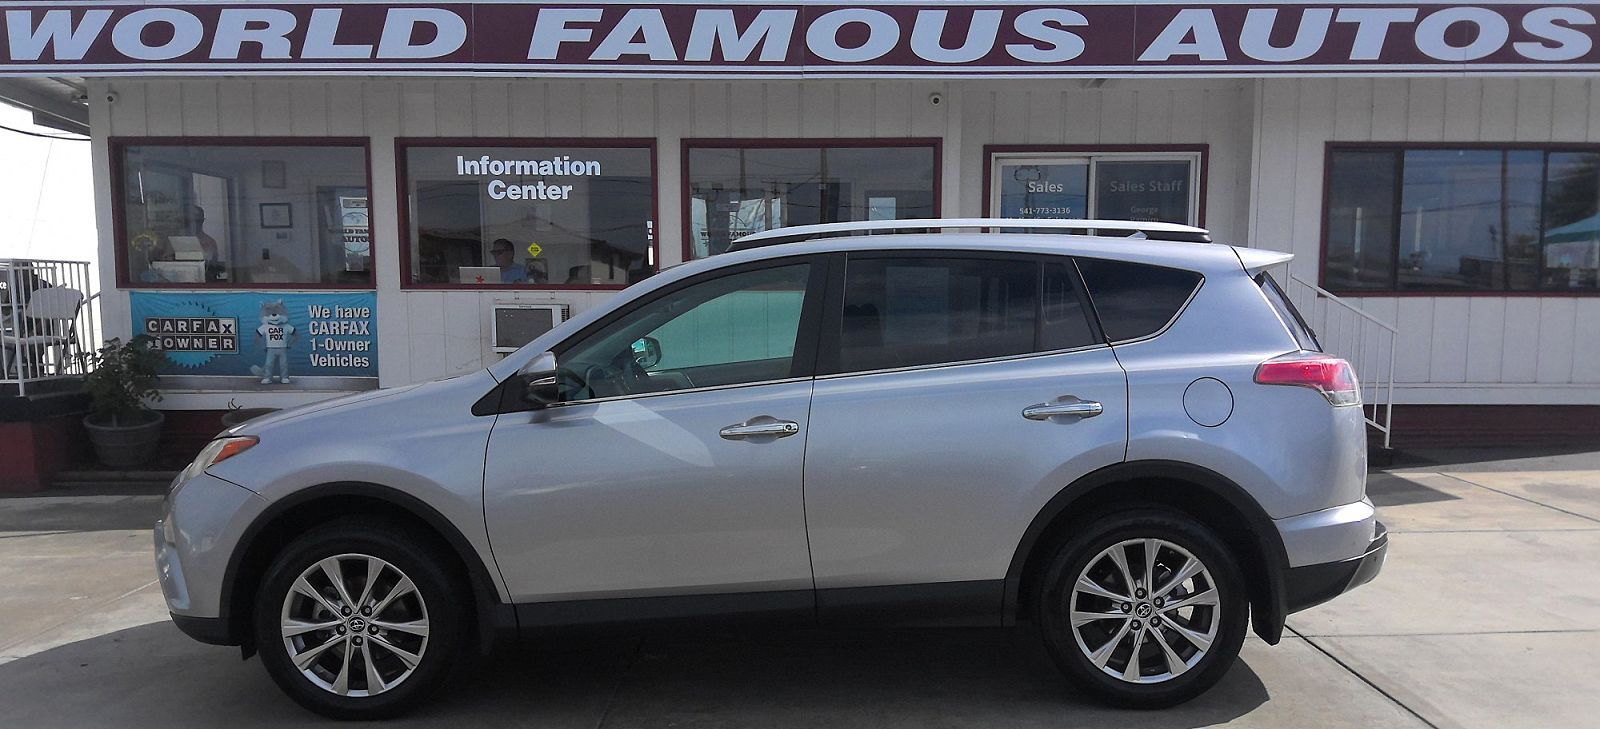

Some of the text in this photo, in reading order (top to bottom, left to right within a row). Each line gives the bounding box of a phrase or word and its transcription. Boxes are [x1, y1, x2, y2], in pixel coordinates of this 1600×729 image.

[3, 6, 1597, 62] WORLD FAMOUS AUTOS
[457, 155, 601, 176] Information
[488, 180, 573, 200] Center
[1028, 180, 1063, 193] Sales
[1110, 179, 1183, 193] Sales Staff
[1019, 207, 1071, 215] 541-773-3136
[308, 304, 370, 318] We have
[148, 320, 233, 334] CARFAX
[308, 321, 370, 335] CARFAX
[163, 338, 233, 349] OWNER
[269, 333, 284, 341] FOX
[310, 337, 370, 351] 1-Owner
[309, 353, 370, 367] Vehicles
